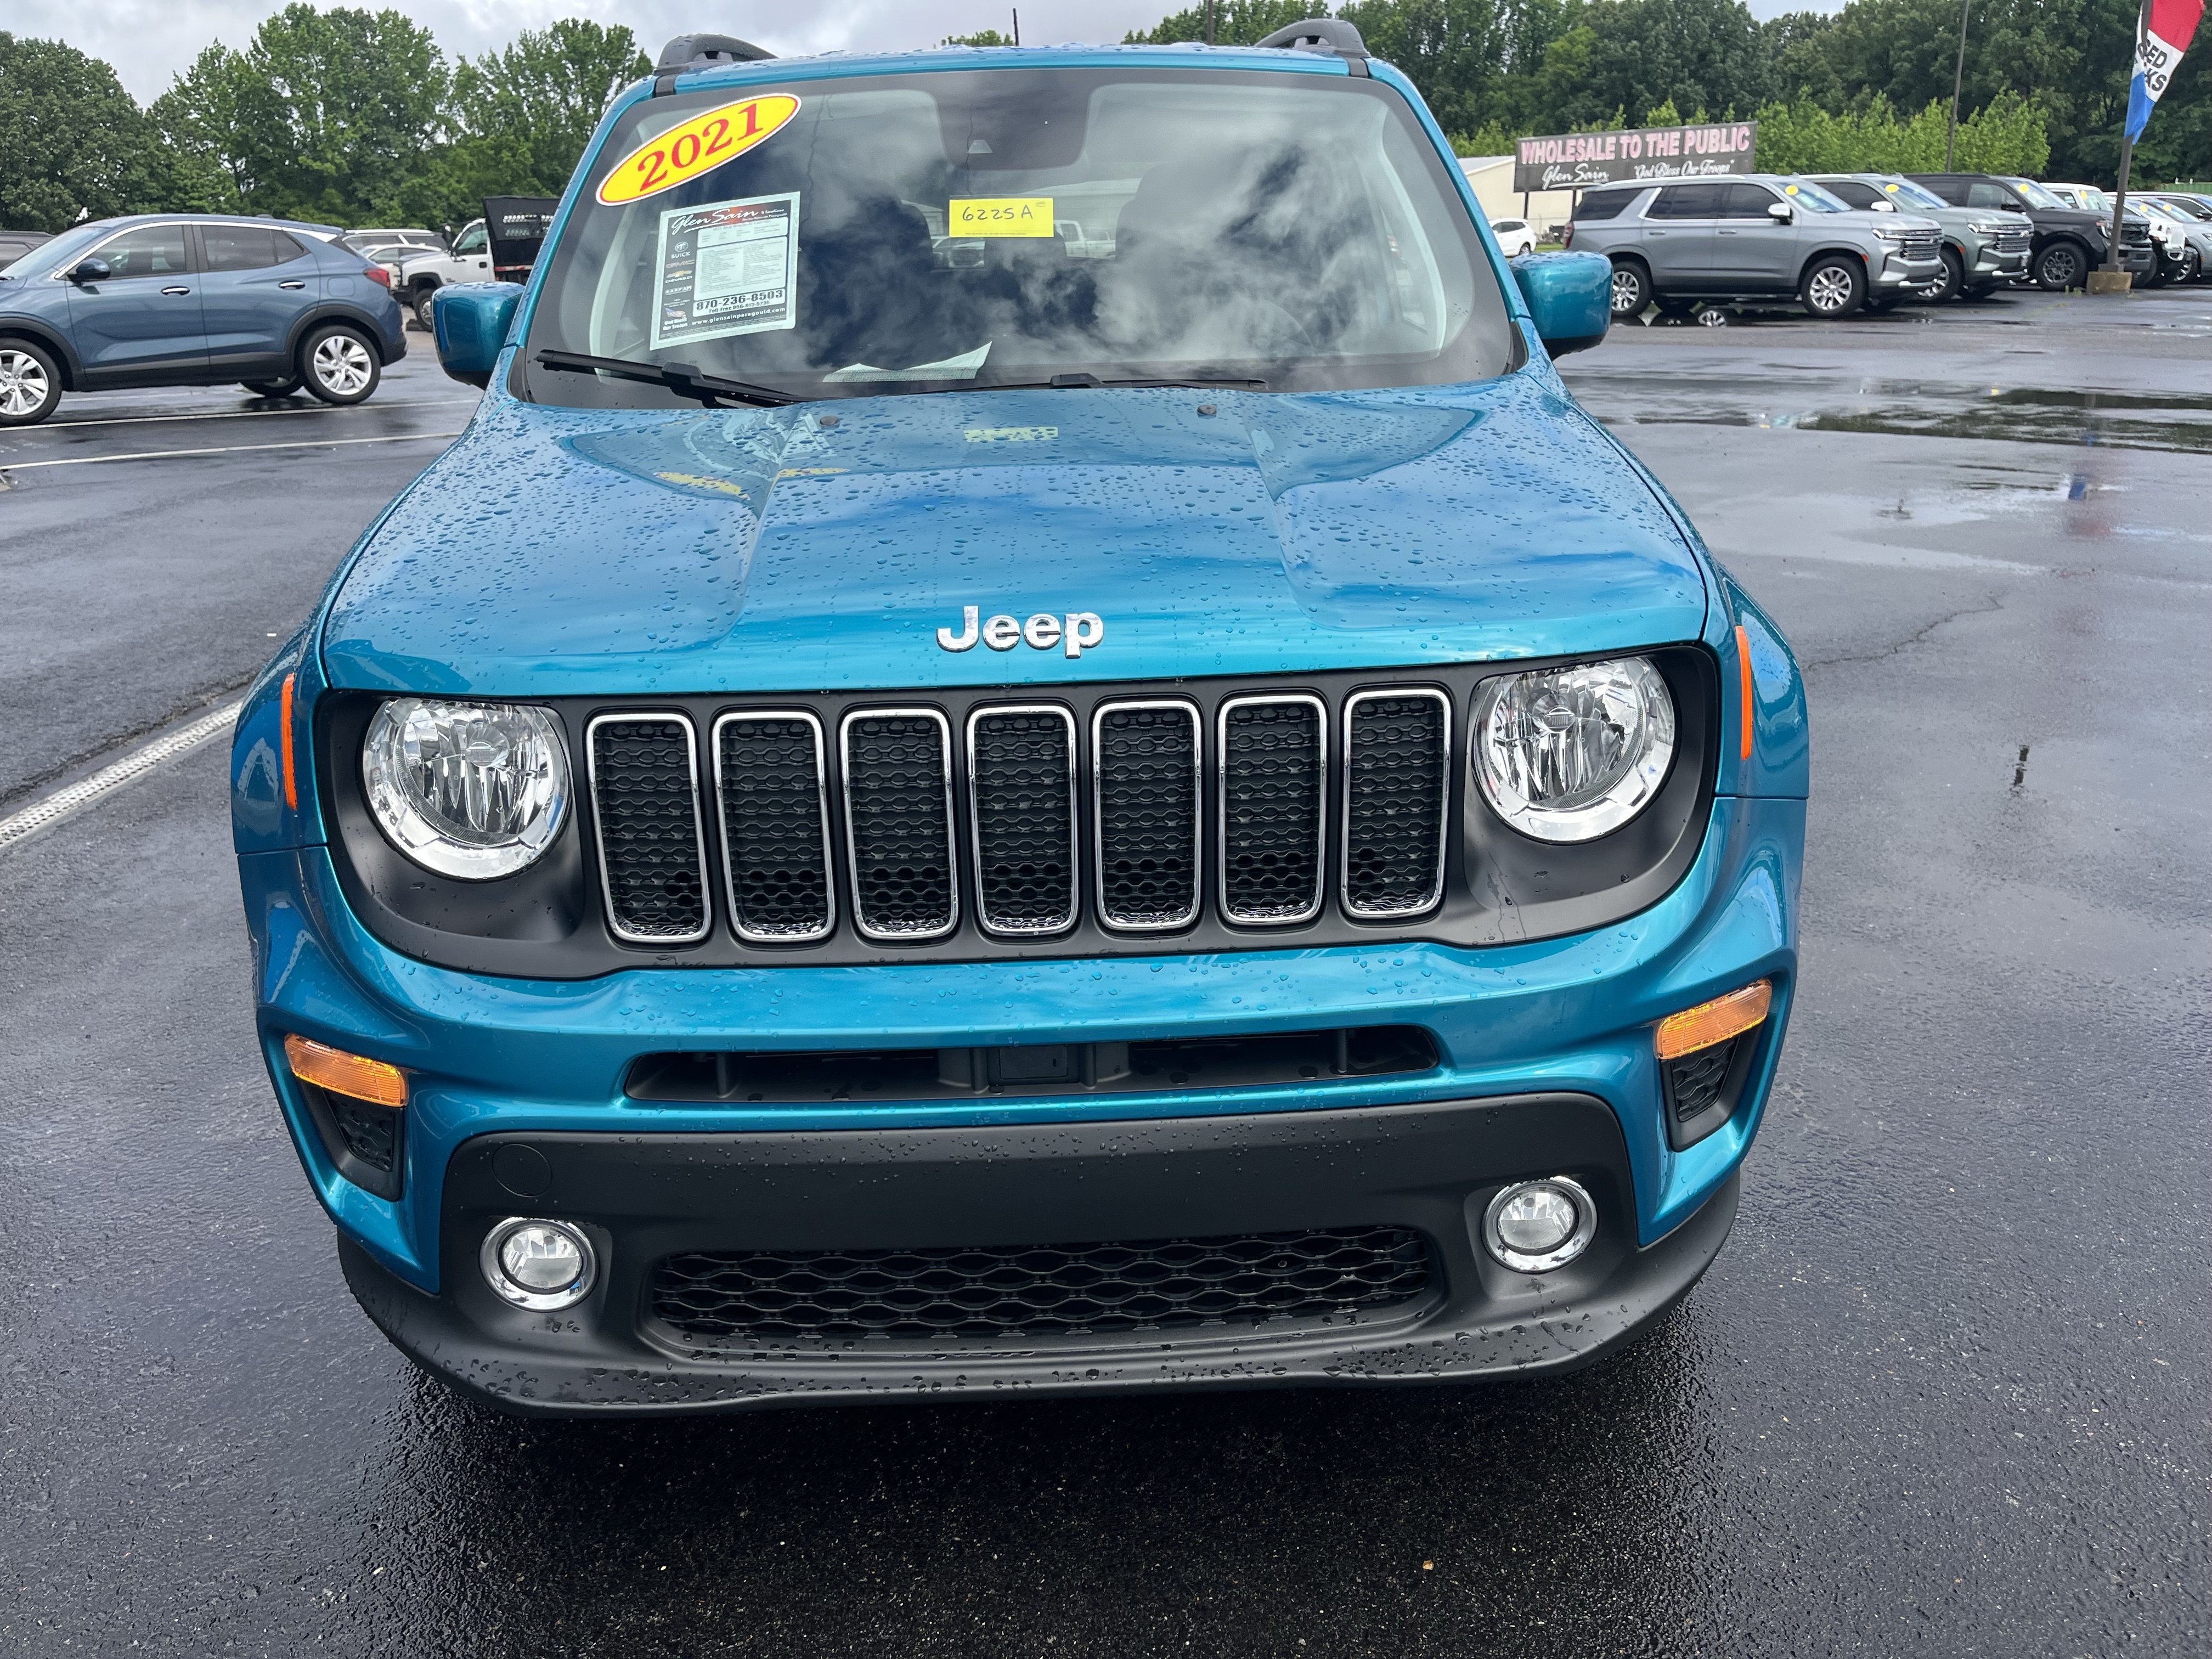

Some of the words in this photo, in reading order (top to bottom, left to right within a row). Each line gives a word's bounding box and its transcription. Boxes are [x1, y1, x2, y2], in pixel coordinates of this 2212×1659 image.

[637, 103, 763, 191] 2021
[1520, 136, 1616, 165] WHOLESALE
[1620, 134, 1643, 160] TO
[1645, 131, 1680, 157] THE
[1683, 126, 1751, 155] PUBLIC
[1542, 165, 1573, 190] Glen
[1574, 163, 1609, 182] Sain
[671, 215, 712, 235] Glen
[712, 208, 759, 224] Sain
[665, 259, 695, 269] GMC
[697, 290, 783, 311] 870-236-8503
[692, 308, 786, 325] www.glensainparagould.com
[936, 605, 1104, 659] Jeep
